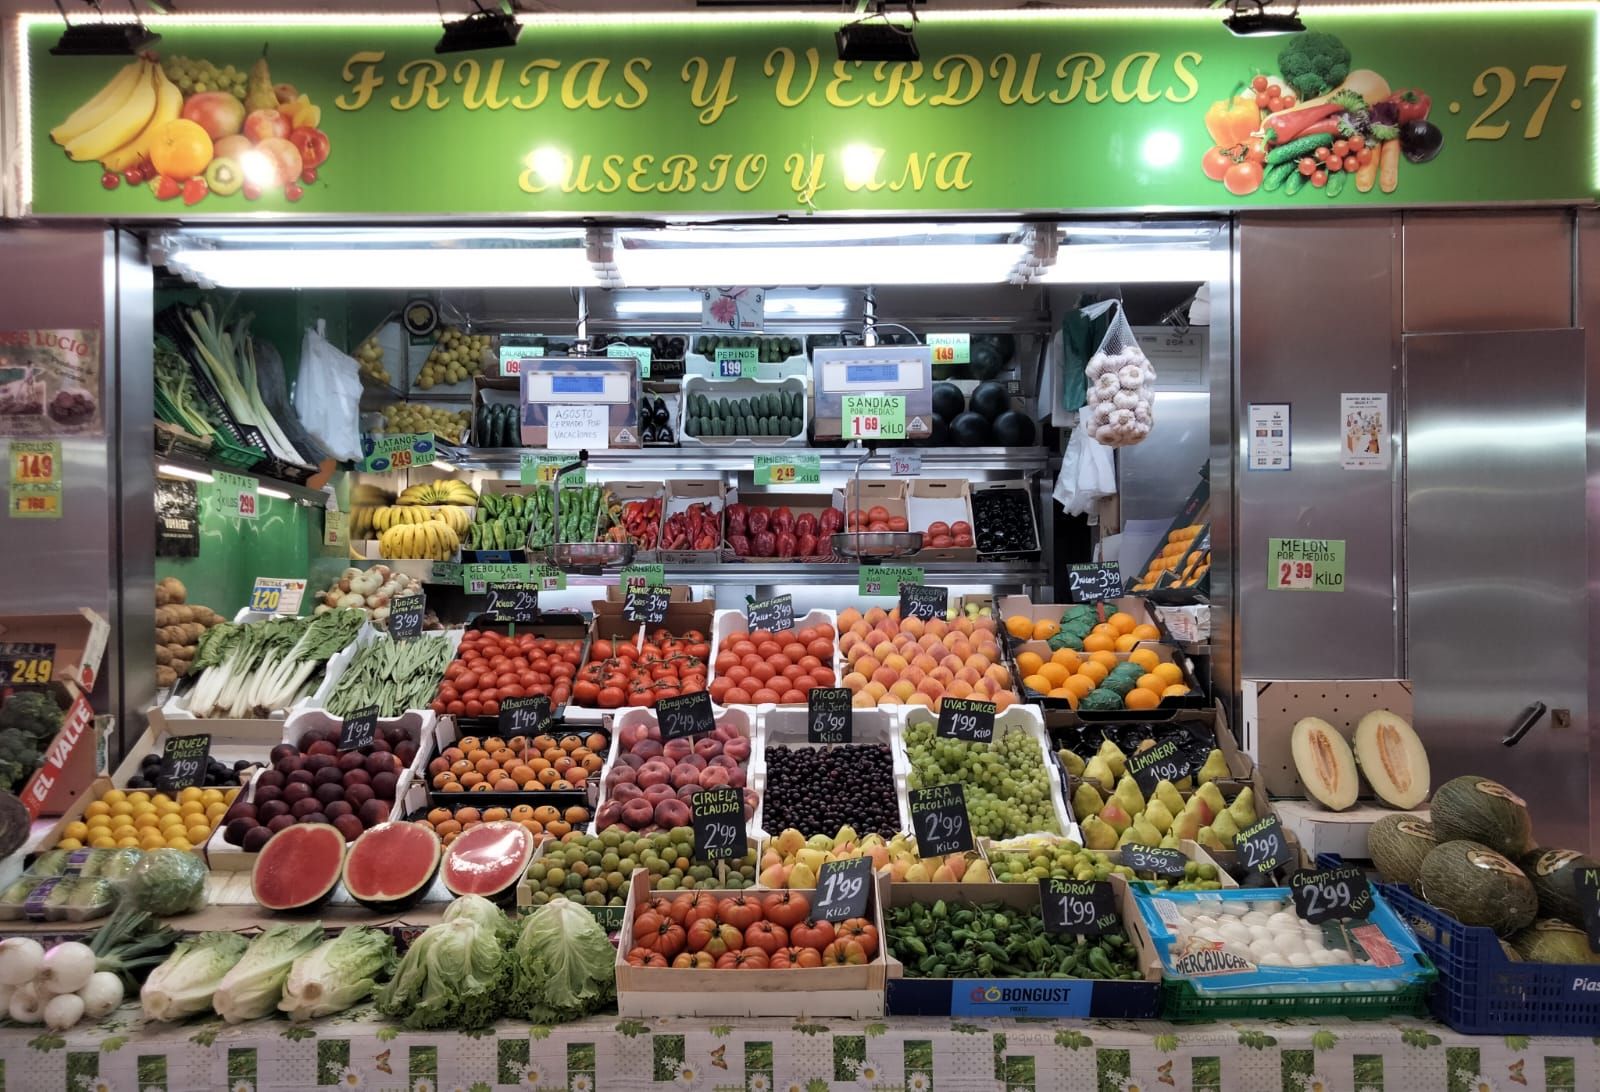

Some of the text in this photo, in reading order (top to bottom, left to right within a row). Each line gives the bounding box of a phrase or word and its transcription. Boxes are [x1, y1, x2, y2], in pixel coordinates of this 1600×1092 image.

[335, 47, 1203, 125] FRUTAS Y VERDURAS
[717, 350, 756, 359] PEPINOS
[721, 360, 741, 376] 199
[847, 397, 899, 408] SANDIAS
[555, 408, 593, 419] AGOSTO
[20, 454, 53, 478] 149
[391, 450, 412, 468] 249
[1277, 551, 1294, 559] POR
[1281, 540, 1328, 552] MELON
[469, 564, 518, 573] CEBOLLAS
[867, 567, 913, 576] MANZANAS
[1070, 571, 1081, 591] 2
[1098, 569, 1120, 588] 3'99
[253, 591, 280, 609] 120
[486, 590, 499, 614] 2
[514, 591, 537, 611] 2'99
[624, 593, 636, 611] 2
[395, 613, 419, 630] 3'99
[749, 611, 758, 628] 2
[12, 659, 52, 683] 249
[812, 689, 849, 700] PICOTA
[944, 698, 996, 714] UVAS DULCES
[511, 708, 538, 730] 1'49
[666, 712, 695, 736] 2'49
[946, 712, 977, 736] 1'99
[343, 720, 370, 744] 1'99
[32, 699, 92, 802] EL VALLE
[165, 736, 209, 752] CIRUELA
[168, 759, 199, 780] 1'99
[1150, 762, 1178, 782] 1'99
[692, 789, 738, 806] CIRUELA
[918, 786, 952, 800] PERA
[695, 802, 741, 817] CLAUDIA
[703, 821, 737, 849] 2'99
[925, 811, 963, 842] 2'99
[1235, 815, 1276, 849] Aguacates
[707, 846, 733, 860] KILO
[1131, 844, 1179, 857] HIGOS
[1246, 833, 1279, 868] 2'99
[826, 857, 863, 873] RAFF
[1133, 853, 1168, 868] 3'99
[817, 871, 863, 907] 1'99
[1302, 881, 1351, 917] 2'99
[825, 906, 851, 919] KILO
[1058, 895, 1096, 926] 1'99
[1175, 949, 1249, 975] MERCAJUCAR
[1002, 987, 1072, 1003] BONGUST
